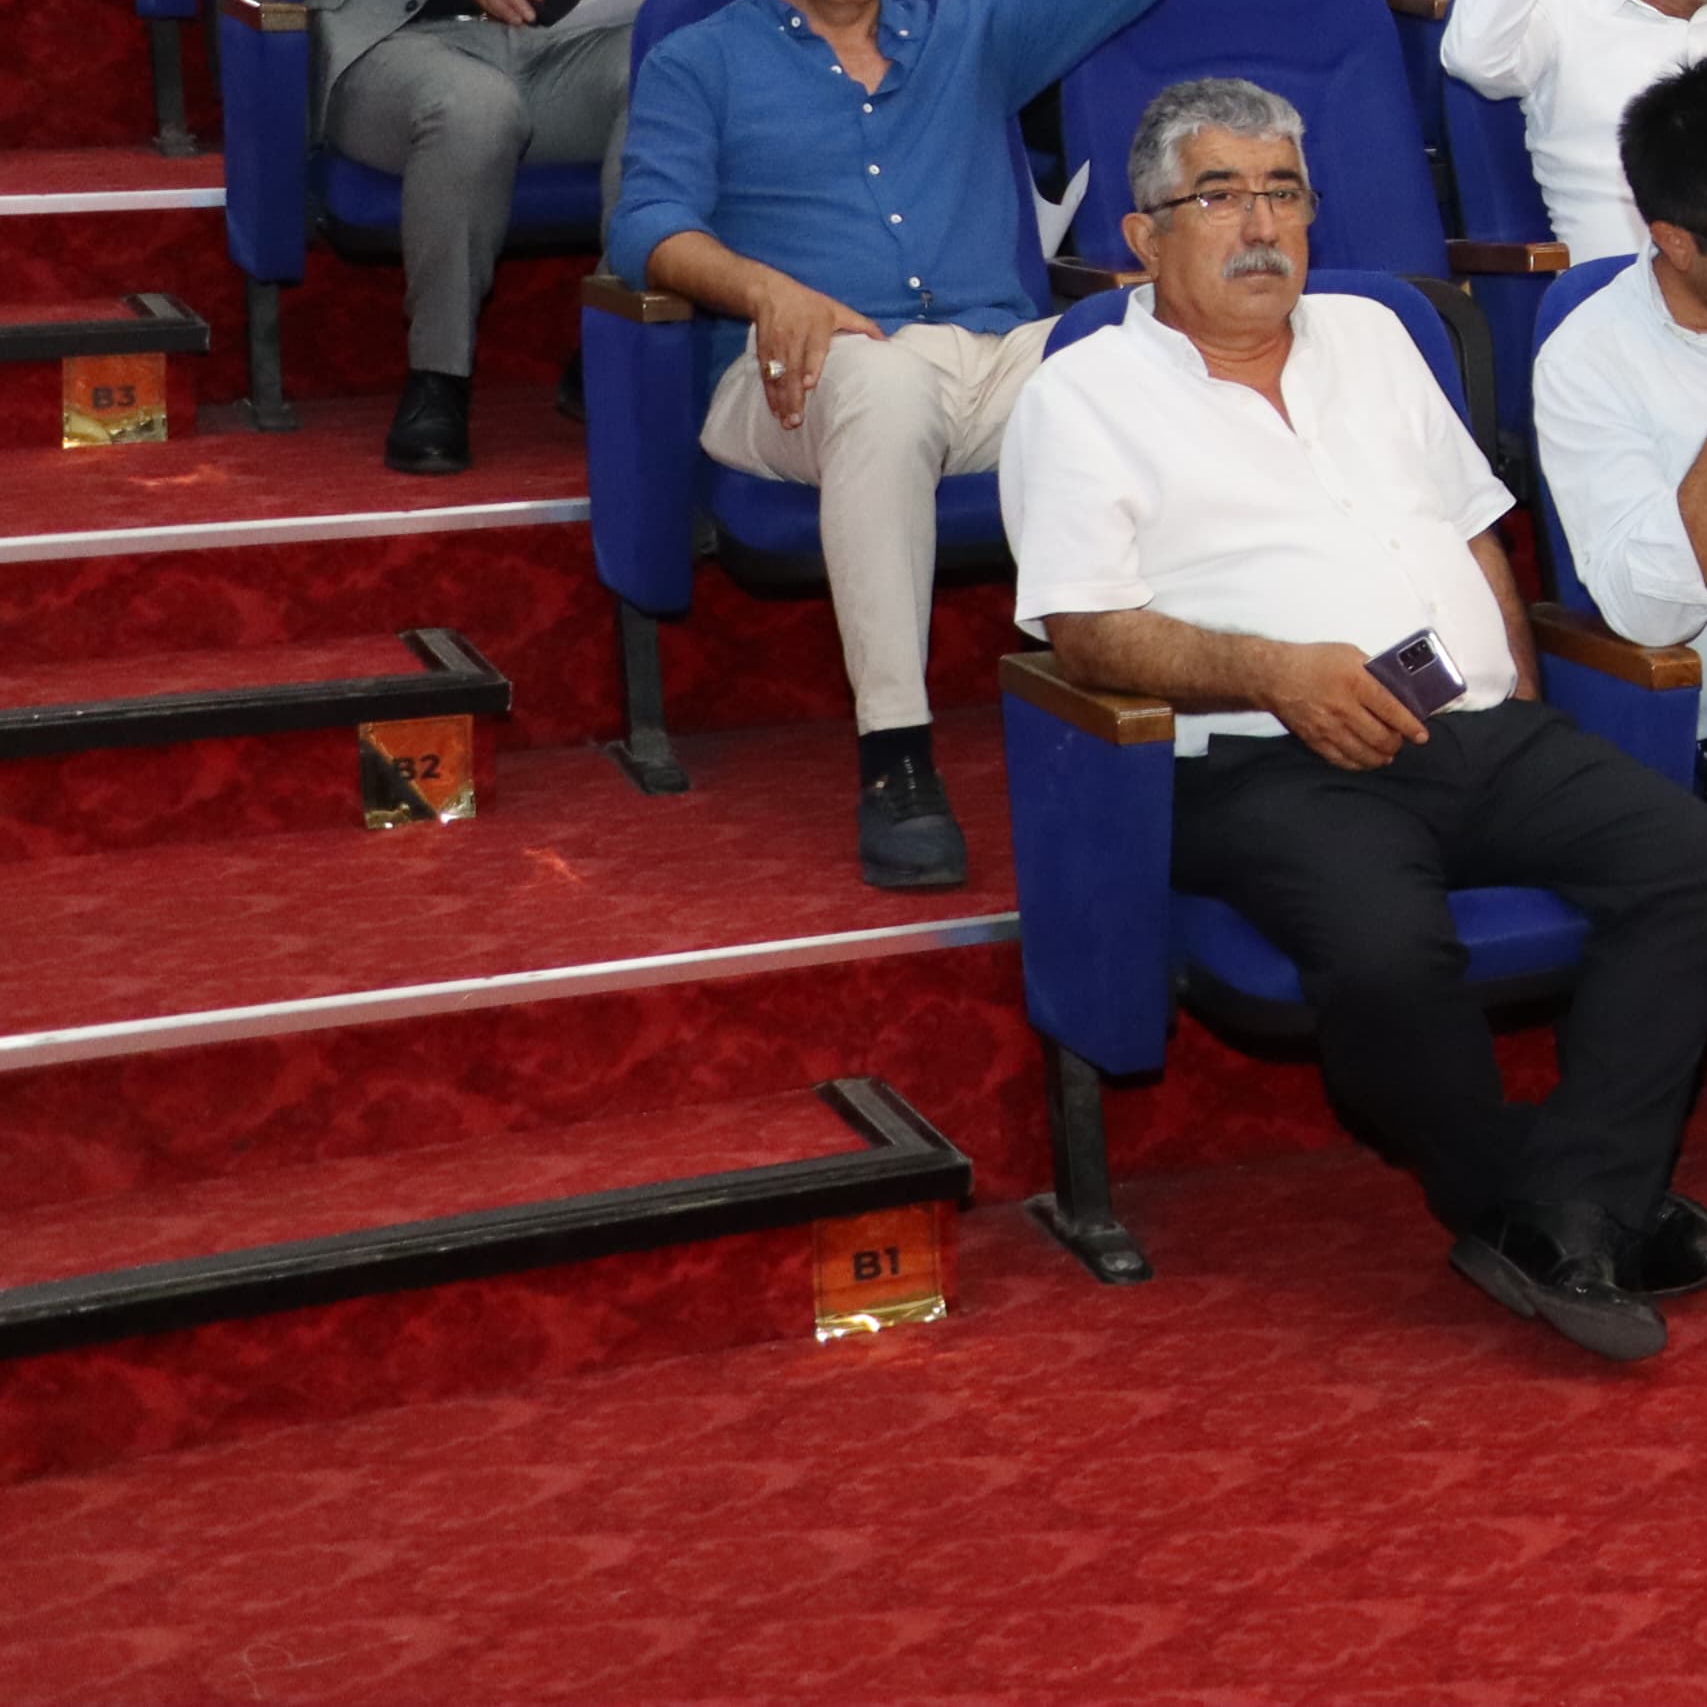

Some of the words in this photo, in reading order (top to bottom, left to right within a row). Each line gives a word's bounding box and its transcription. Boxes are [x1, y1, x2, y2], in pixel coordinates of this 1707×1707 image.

[92, 385, 137, 409] B3
[394, 754, 441, 781] B2
[853, 1247, 900, 1281] B1
